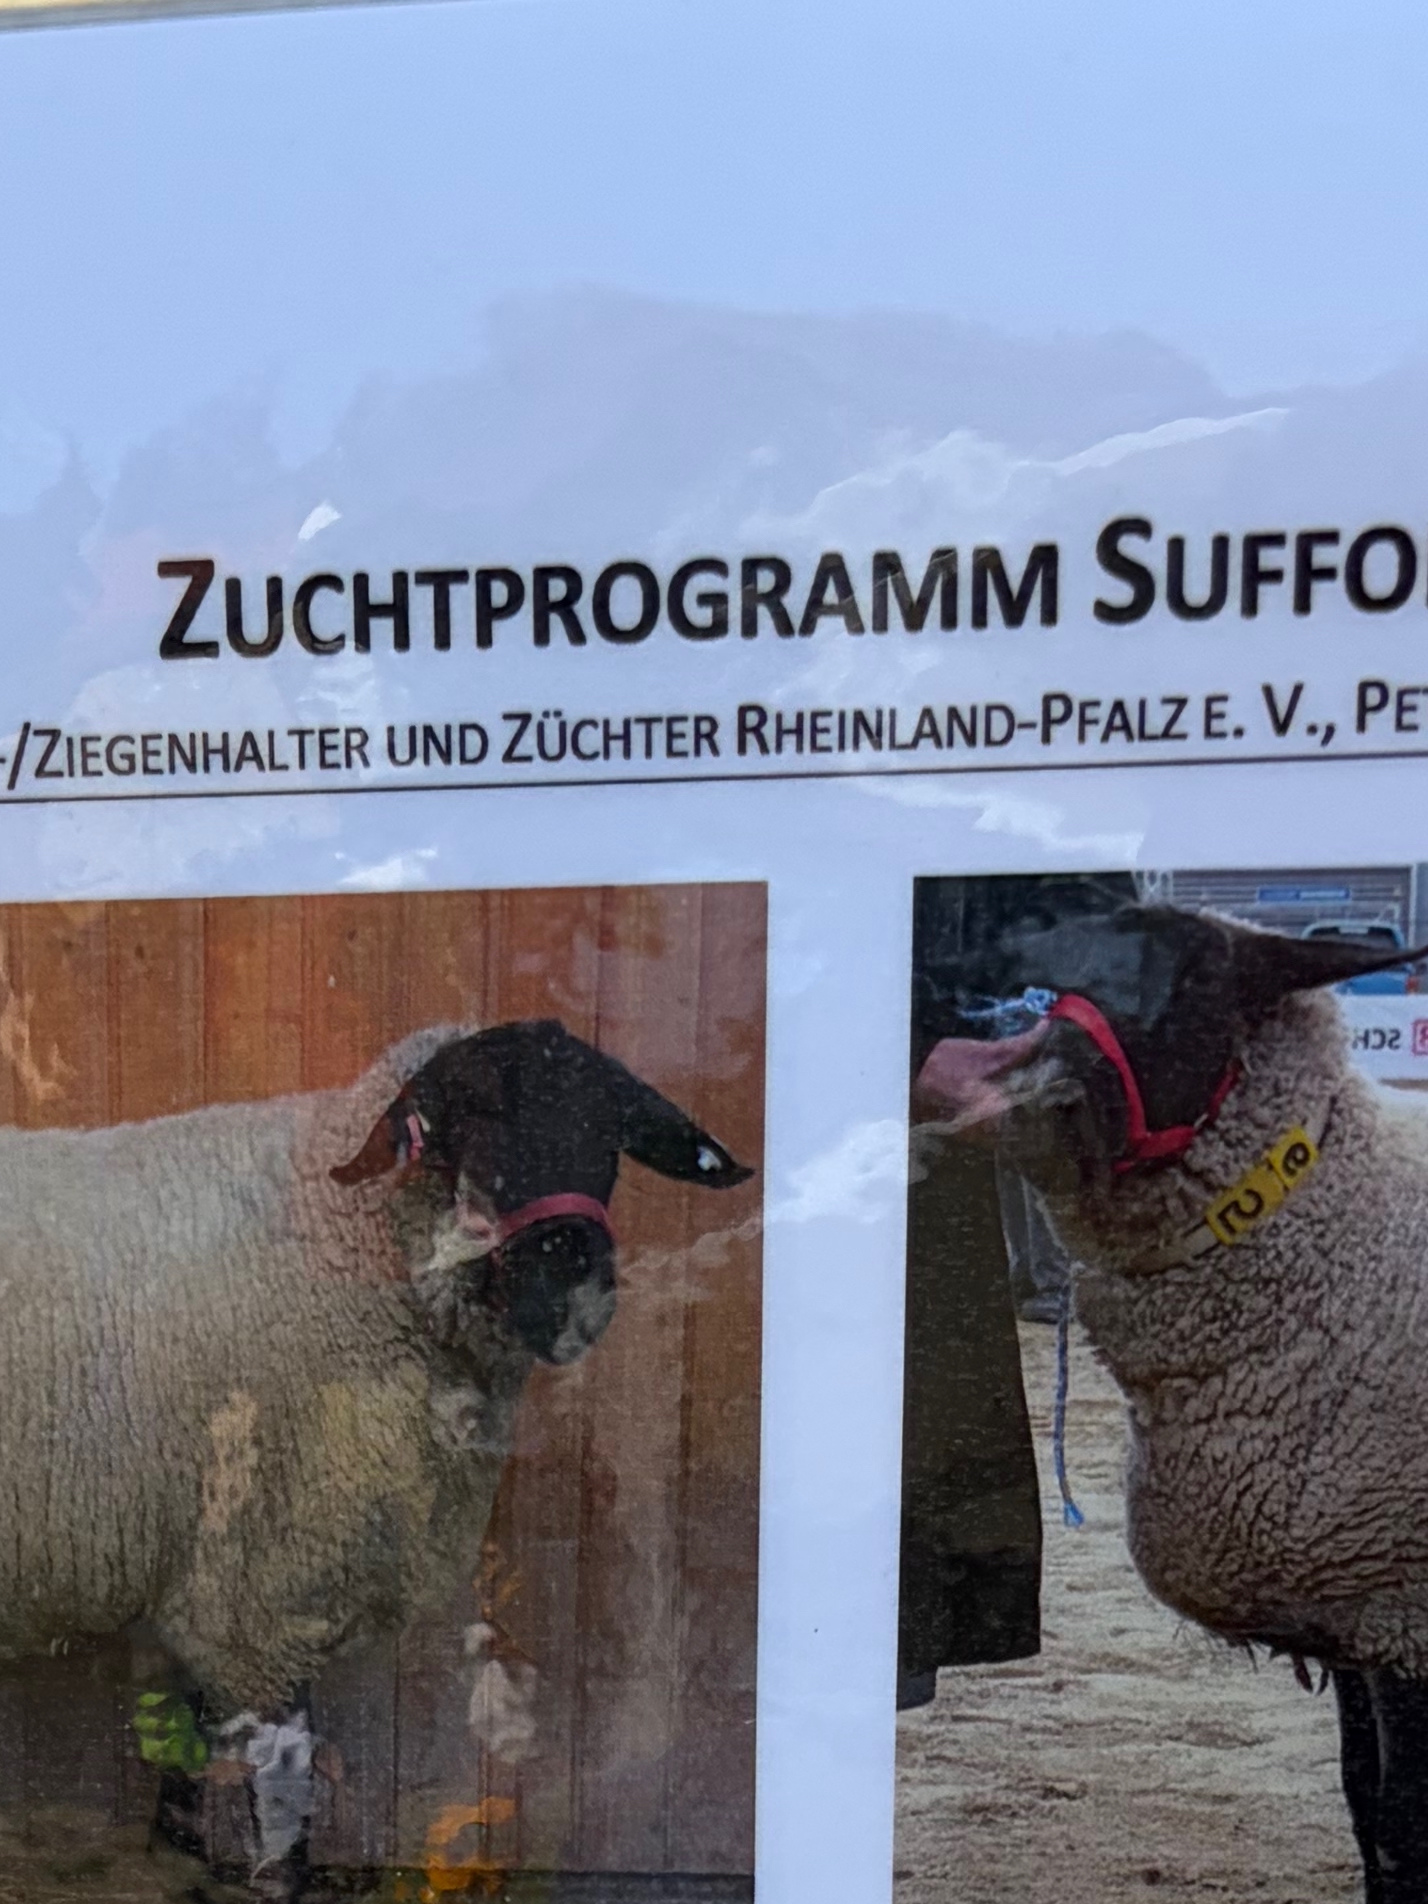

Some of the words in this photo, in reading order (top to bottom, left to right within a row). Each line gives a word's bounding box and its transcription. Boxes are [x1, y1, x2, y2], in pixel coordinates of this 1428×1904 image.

[156, 541, 1060, 661] ZUCHTPROGRAMM
[386, 722, 490, 767] UND
[501, 709, 721, 764] ZÜCHTER
[736, 691, 1189, 757] RHEINLAND-PFALZ
[1203, 693, 1245, 741] E.
[1261, 682, 1337, 748] V.,
